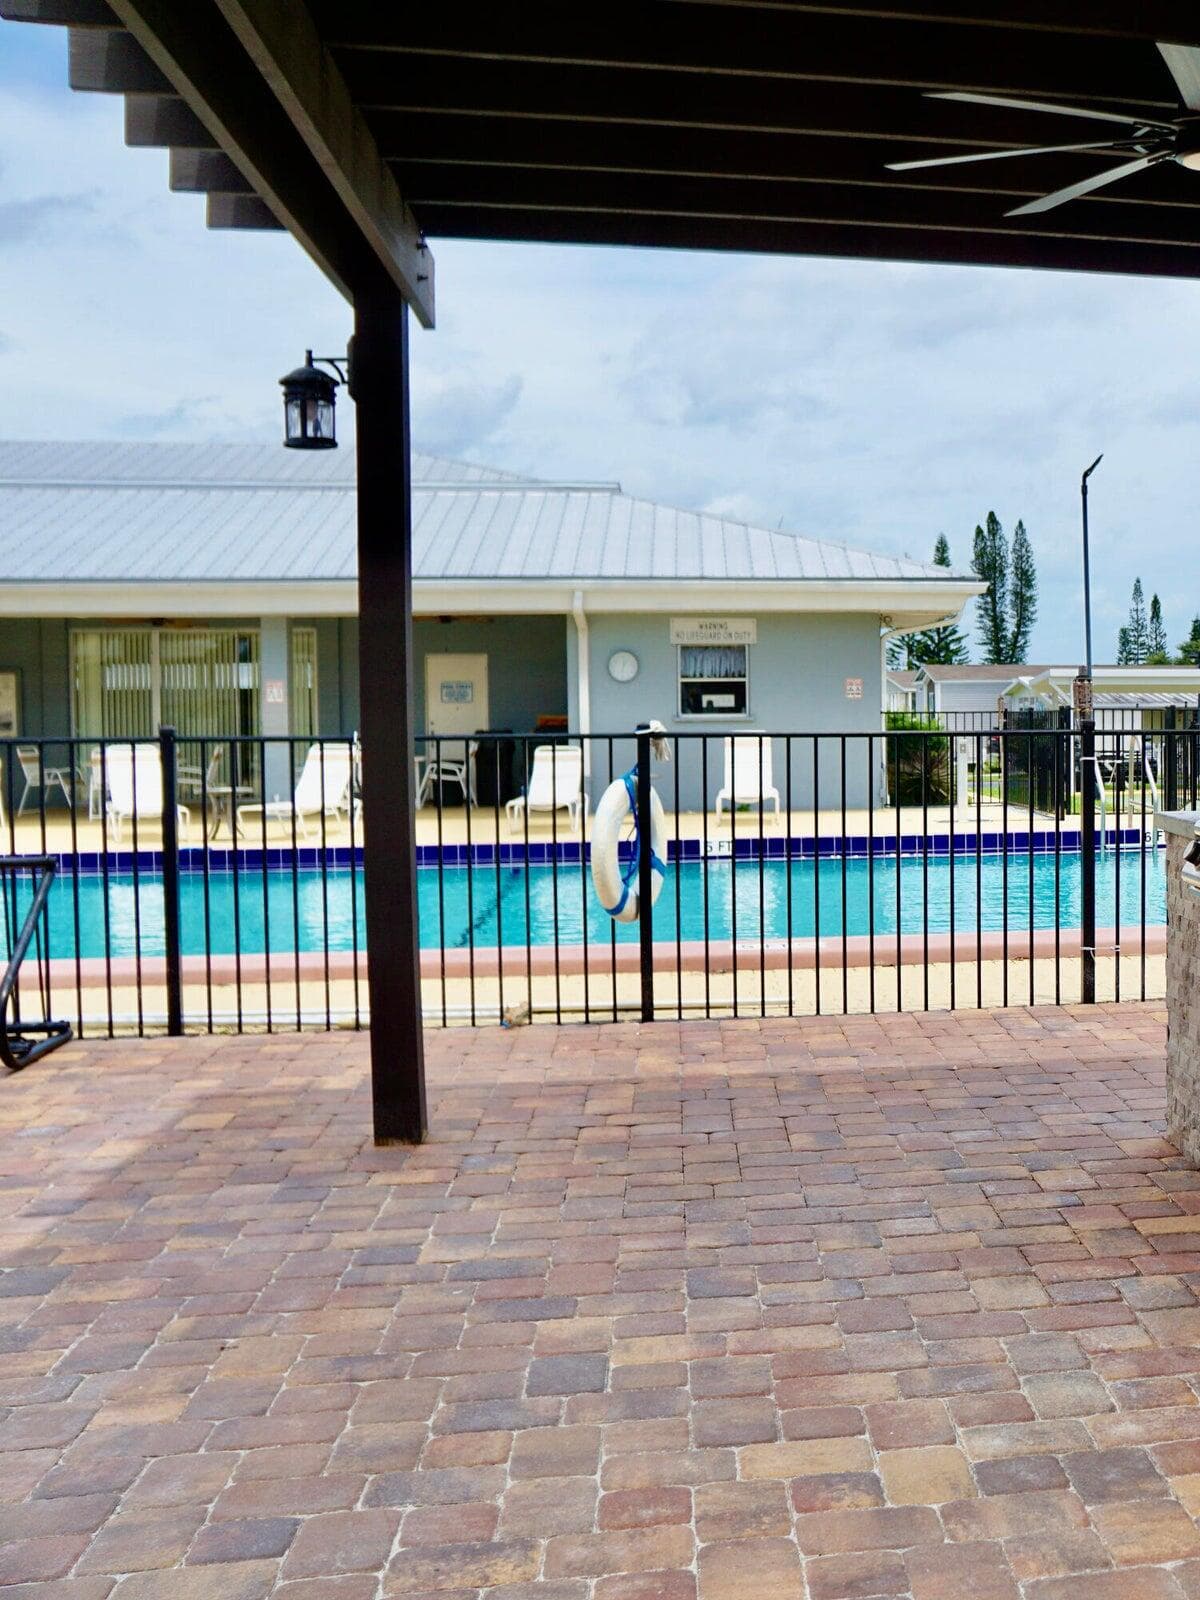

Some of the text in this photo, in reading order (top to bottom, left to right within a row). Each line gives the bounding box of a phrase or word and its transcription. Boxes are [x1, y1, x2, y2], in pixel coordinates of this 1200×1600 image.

[698, 622, 728, 630] WARNING
[675, 631, 751, 640] NO LIFEGUARD ON DUTY
[718, 841, 733, 852] FT
